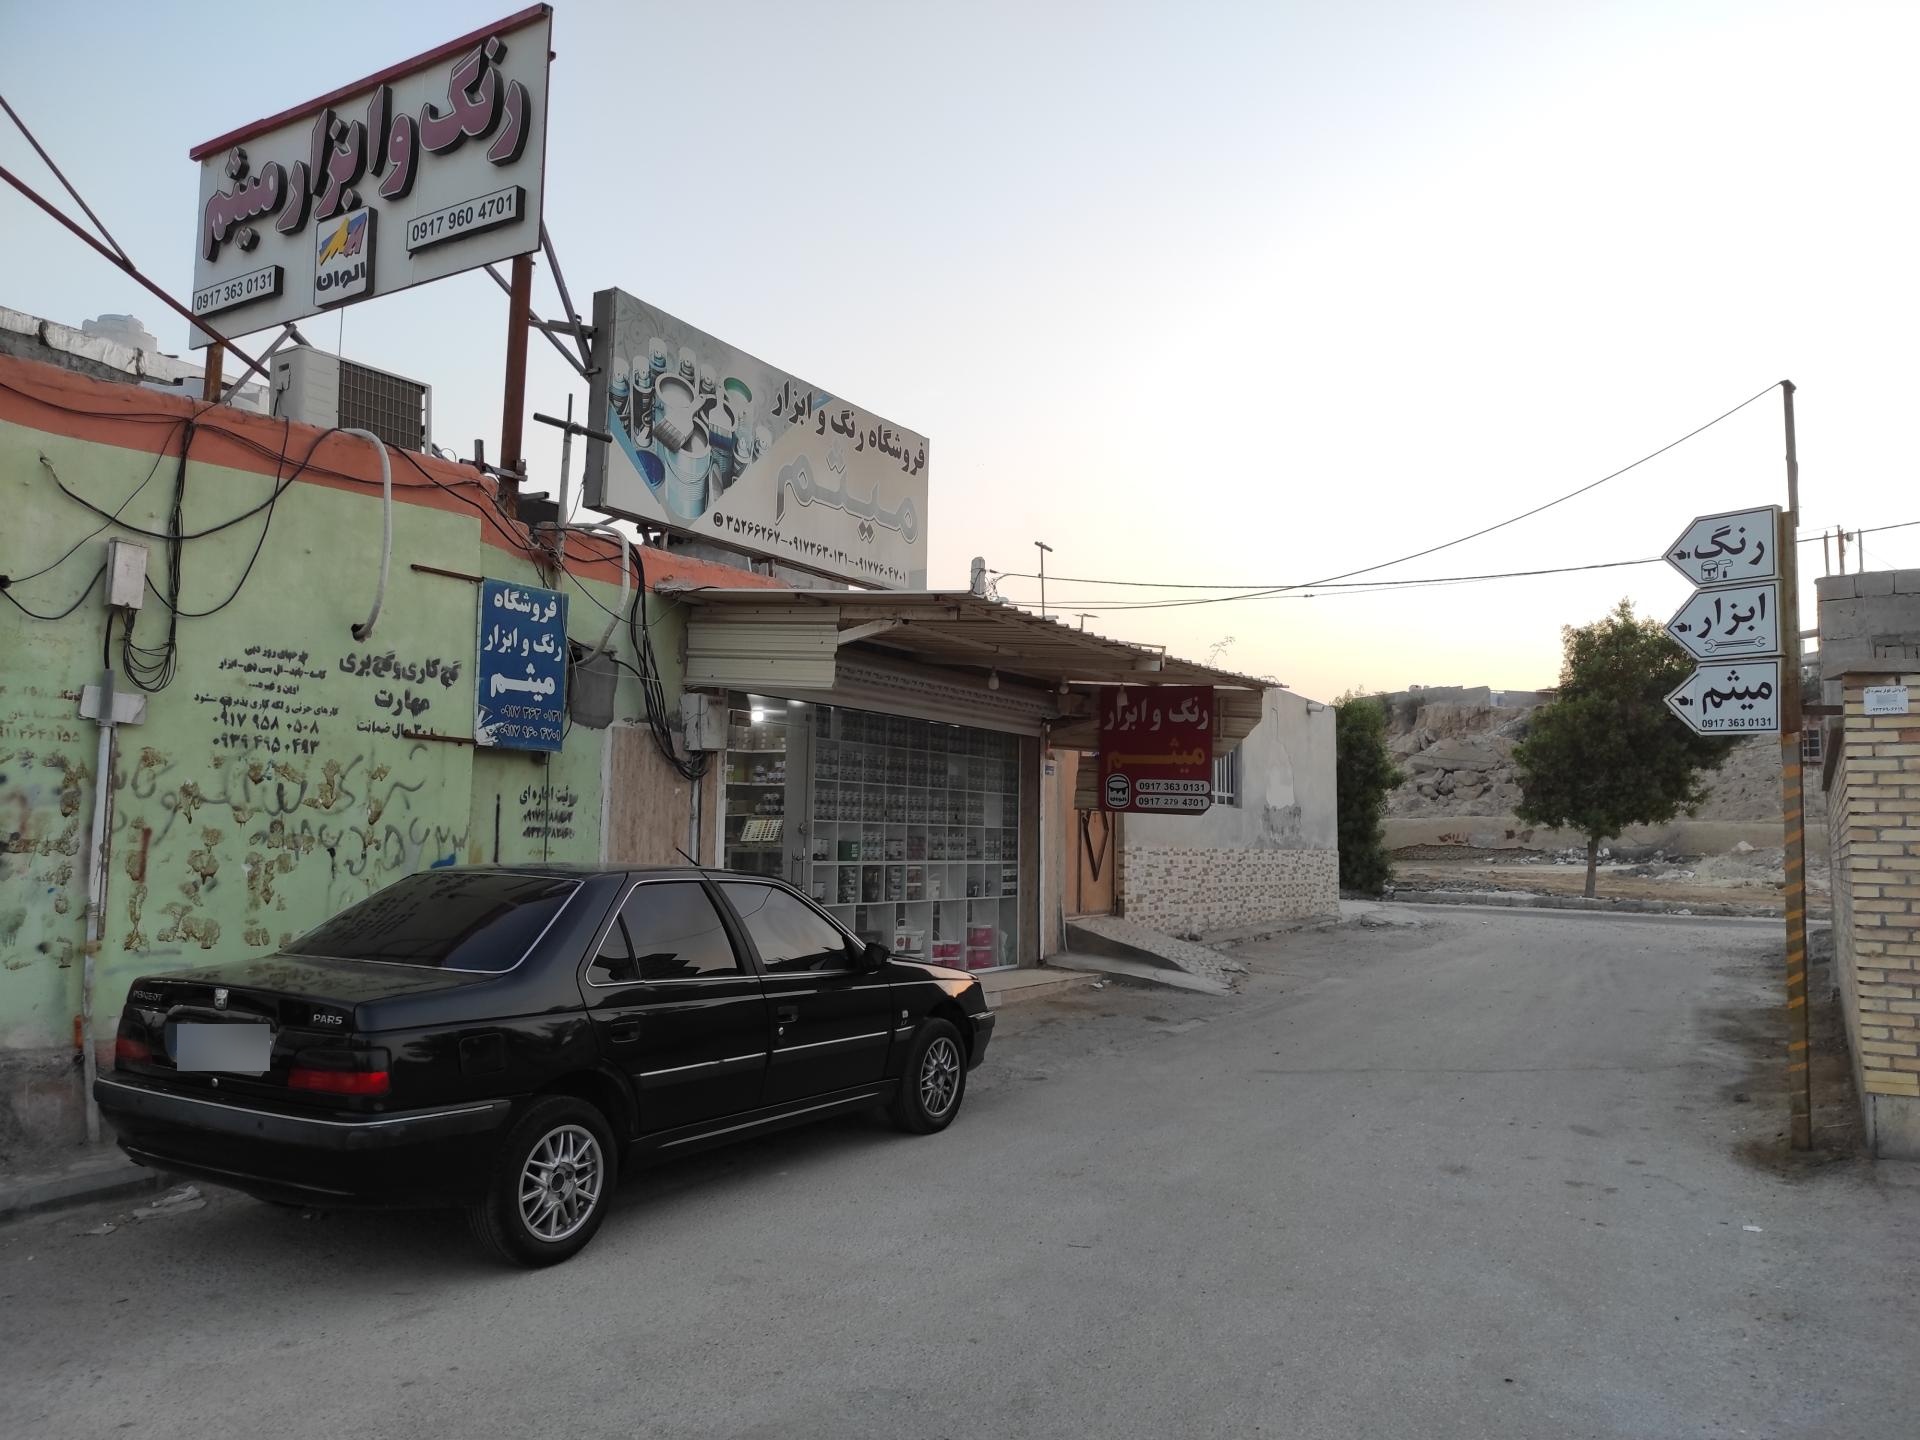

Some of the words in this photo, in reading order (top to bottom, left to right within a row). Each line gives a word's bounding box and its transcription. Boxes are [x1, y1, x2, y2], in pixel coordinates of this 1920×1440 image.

[420, 36, 531, 166] رنگ
[276, 84, 392, 234] ابزار
[379, 112, 419, 199] و
[203, 145, 287, 262] میثم
[412, 217, 444, 242] 0917
[447, 207, 475, 231] 960
[478, 193, 514, 221] 4701
[196, 287, 221, 311] 0917
[223, 278, 244, 301] 363
[246, 271, 273, 295] 0131
[316, 262, 366, 292] الوان
[771, 379, 812, 425] ابزار
[816, 409, 826, 435] و
[831, 410, 864, 452] رنگ
[868, 424, 925, 475] فروشگاه
[1694, 525, 1765, 565] رنگ
[494, 588, 557, 623] فروشگاه
[1697, 592, 1766, 638] ابزار
[484, 624, 518, 653] ابزار
[521, 638, 529, 656] و
[533, 634, 562, 661] رنگ
[490, 663, 556, 701] میثم
[1702, 670, 1773, 716] میثم
[1150, 708, 1161, 731] و
[1169, 696, 1209, 729] رنگ
[1702, 718, 1724, 728] 0917
[1728, 718, 1745, 727] 363
[1748, 717, 1772, 727] 0131
[1106, 738, 1205, 773] میثم
[1138, 797, 1160, 805] 0917
[1139, 782, 1160, 791] 0917
[1163, 782, 1180, 791] 363
[1183, 783, 1205, 791] 0131
[313, 1013, 343, 1025] PARS
